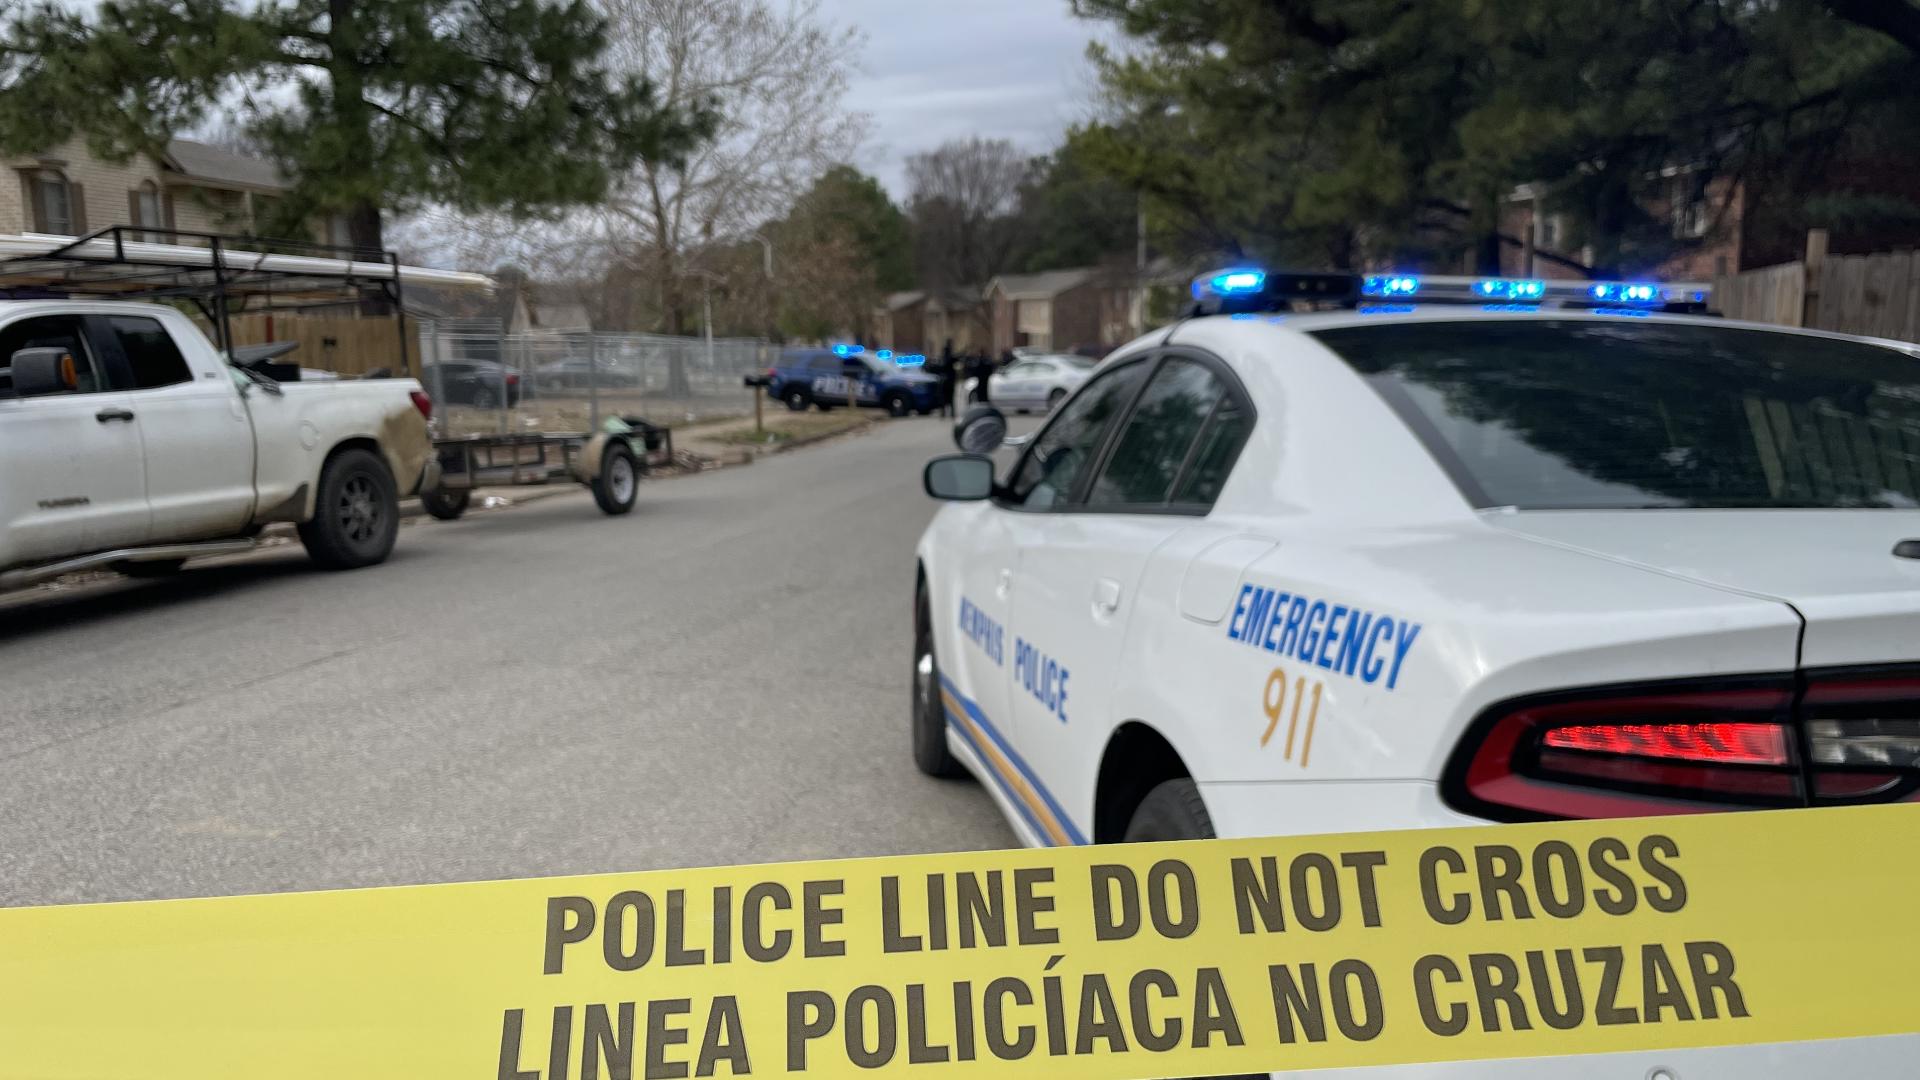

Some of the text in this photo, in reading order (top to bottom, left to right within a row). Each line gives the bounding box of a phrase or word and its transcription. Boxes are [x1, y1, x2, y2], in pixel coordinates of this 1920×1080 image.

[958, 596, 1070, 723] MEMPHIS POLICE
[1228, 583, 1422, 692] EMERGENCY
[1260, 667, 1323, 769] 911
[543, 834, 1688, 975] POLICE LINE DO NOT CROSS
[497, 940, 1752, 1080] LINEA POLICÍACA NO CRUZAR
